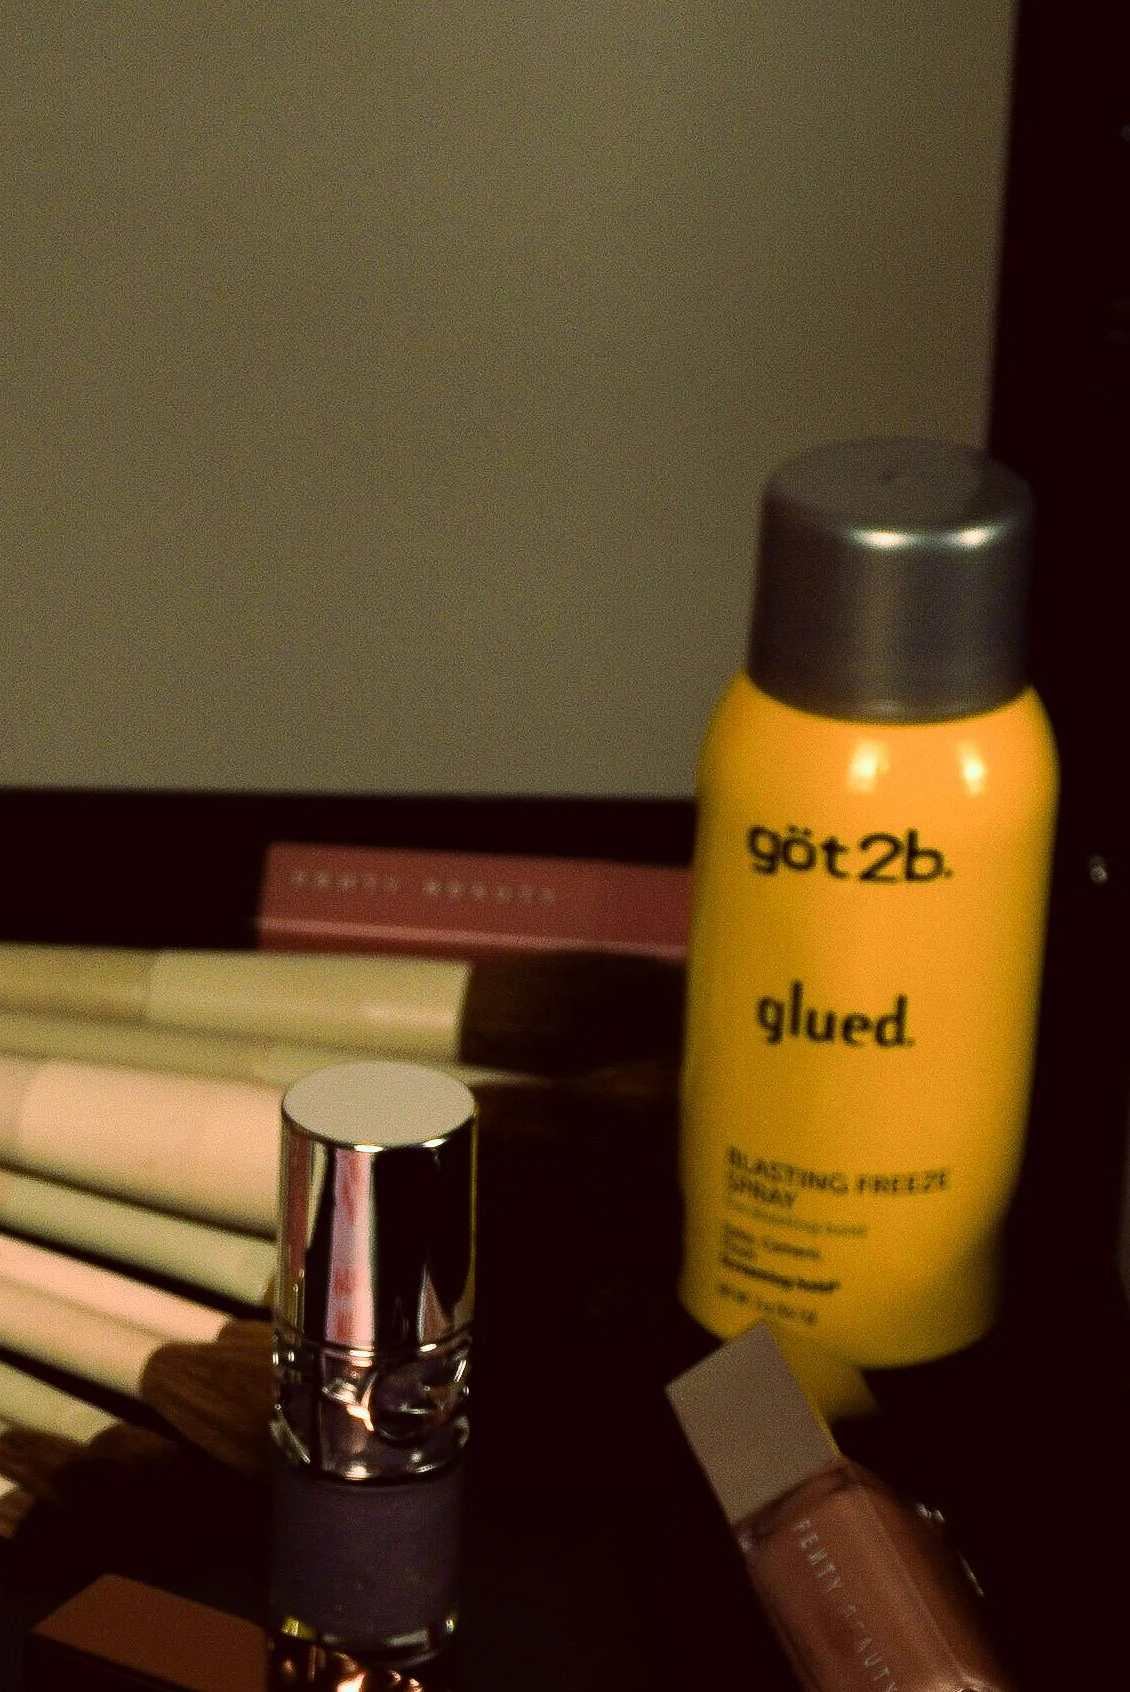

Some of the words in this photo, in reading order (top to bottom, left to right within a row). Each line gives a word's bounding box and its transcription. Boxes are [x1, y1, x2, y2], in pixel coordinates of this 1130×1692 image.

[727, 1145, 849, 1195] BLASTING
[855, 1168, 950, 1196] FREEZE
[791, 1517, 844, 1595] FENTY
